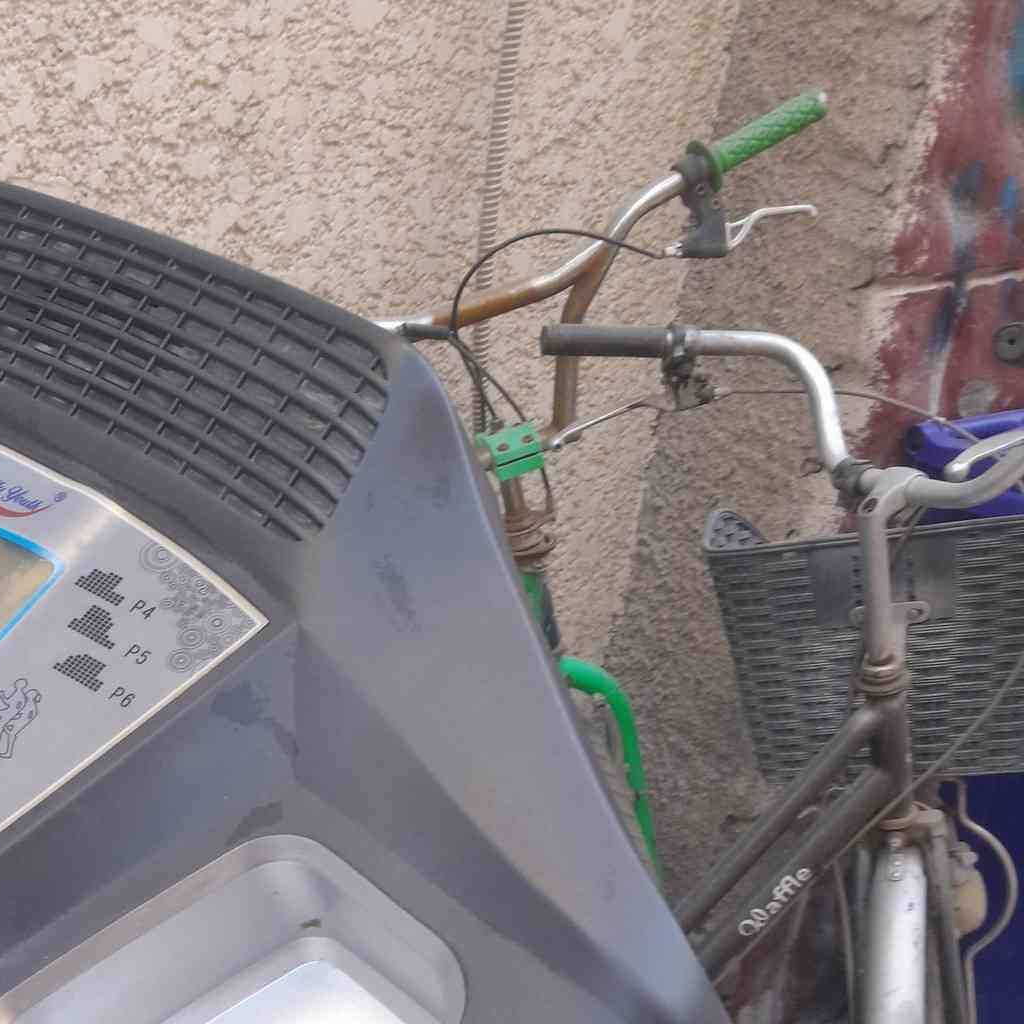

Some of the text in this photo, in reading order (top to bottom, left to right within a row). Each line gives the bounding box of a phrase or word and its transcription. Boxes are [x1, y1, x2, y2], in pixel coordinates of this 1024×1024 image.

[129, 599, 156, 620] P4
[124, 643, 152, 665] P5
[108, 686, 136, 708] P6
